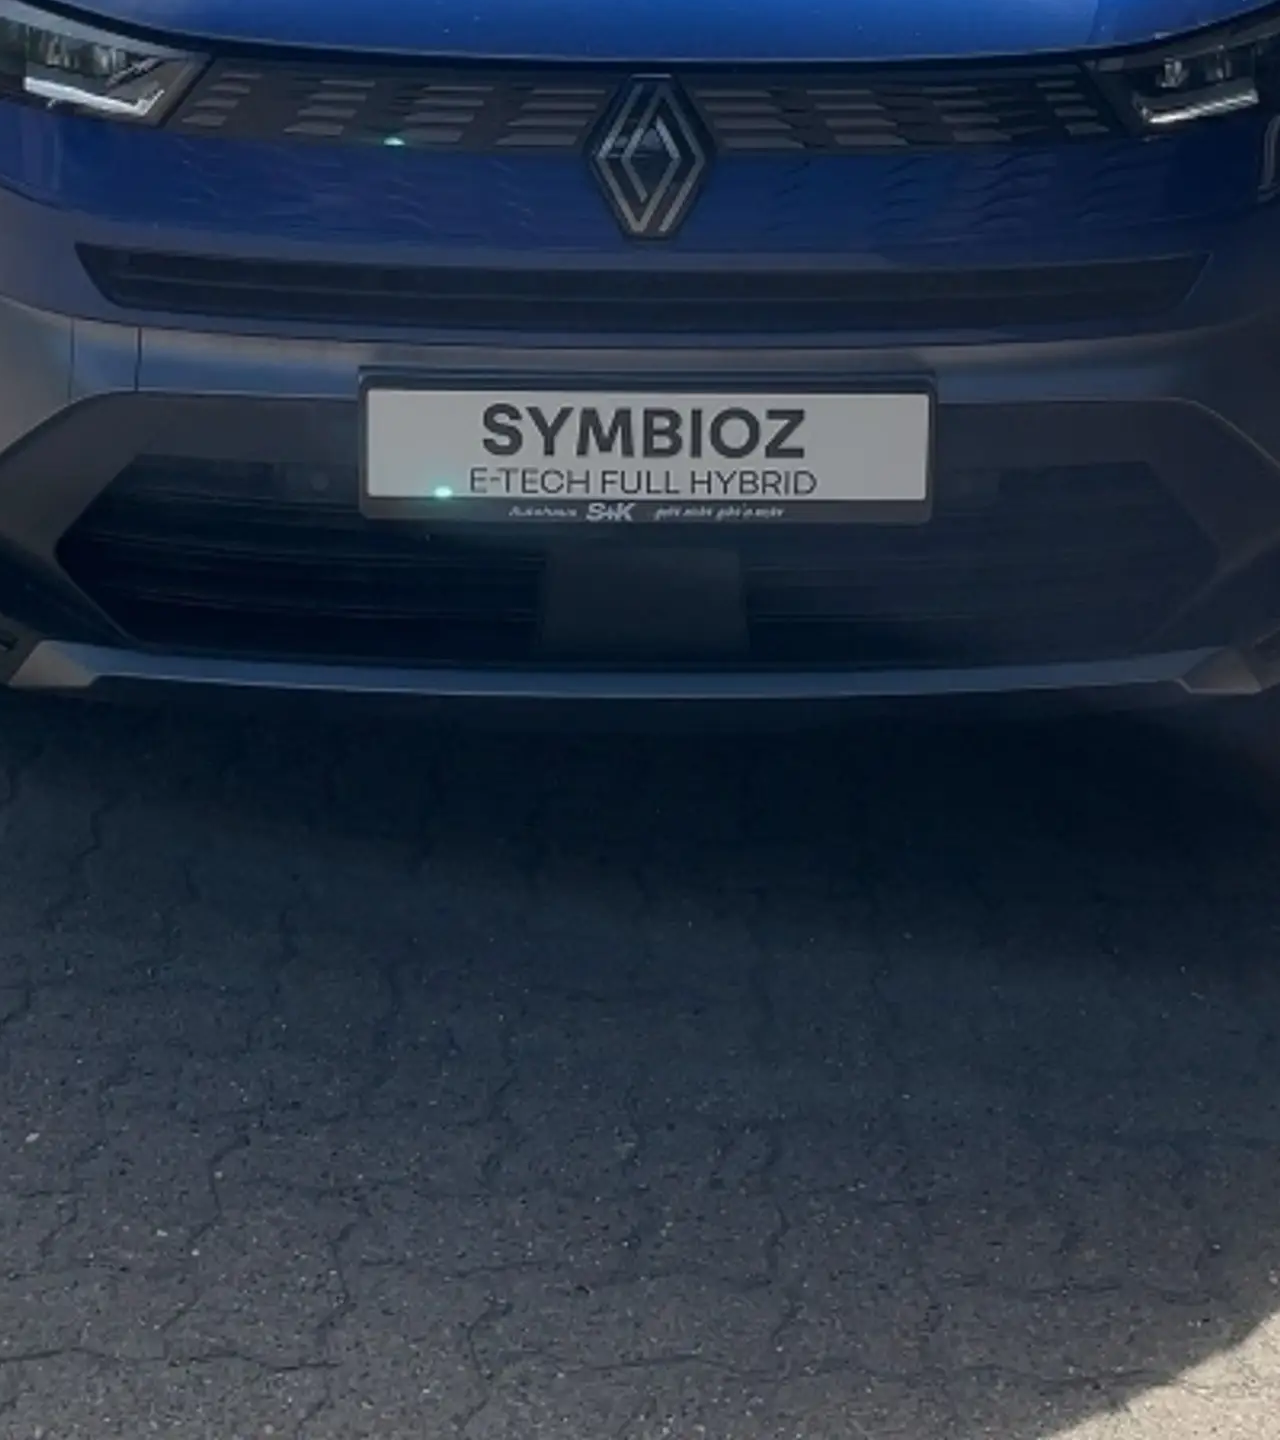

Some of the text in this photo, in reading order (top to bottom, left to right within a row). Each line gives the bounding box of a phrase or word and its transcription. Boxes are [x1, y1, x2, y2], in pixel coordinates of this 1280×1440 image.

[481, 402, 807, 459] SYMBIOZ
[469, 466, 818, 497] E-TECH FULL HYBRID
